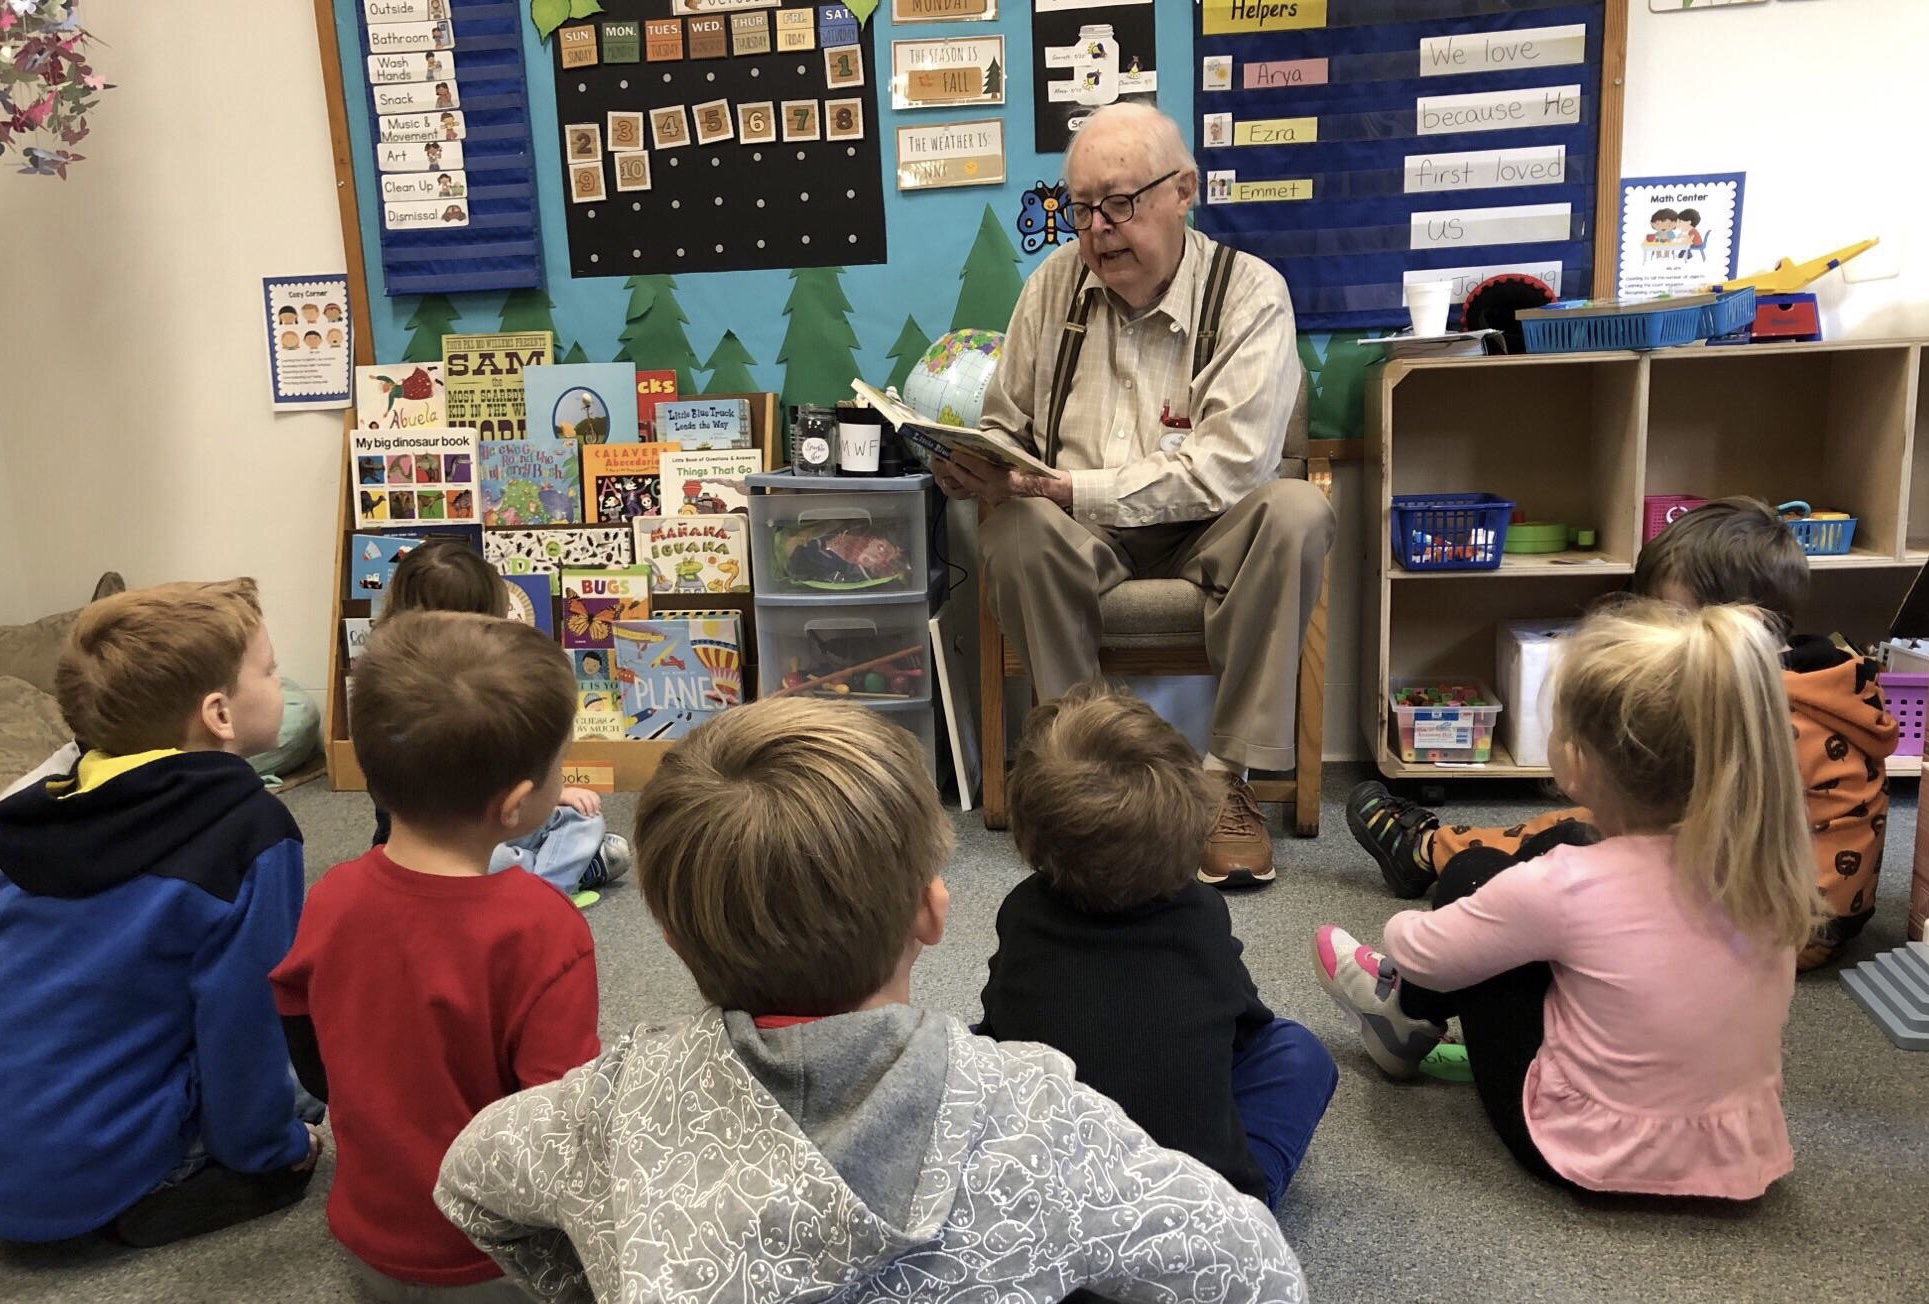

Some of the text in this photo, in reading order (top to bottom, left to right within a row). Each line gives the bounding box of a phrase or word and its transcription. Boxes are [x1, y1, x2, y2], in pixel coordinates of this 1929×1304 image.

[370, 1, 414, 15] Outside
[825, 9, 854, 20] SAT.
[1231, 0, 1298, 26] Helpers
[606, 26, 636, 36] MON.
[648, 24, 682, 35] TUES.
[692, 21, 723, 32] WED.
[372, 33, 429, 46] Bathroom
[566, 31, 591, 41] SUN.
[568, 50, 592, 63] SUNDAY
[909, 49, 924, 64] THE
[930, 46, 963, 63] SEASON
[1430, 37, 1540, 66] We love
[377, 57, 409, 68] Wash
[838, 55, 852, 77] 1
[377, 69, 412, 81] Hands
[1258, 63, 1303, 86] Arya
[943, 72, 969, 93] FALL
[380, 93, 414, 105] Snack
[1423, 92, 1576, 129] because He
[388, 116, 431, 130] Music &
[662, 116, 678, 137] 4
[705, 110, 722, 133] 5
[750, 112, 765, 132] 6
[793, 109, 809, 130] 7
[836, 108, 854, 130] 8
[381, 130, 438, 142] Movement
[617, 121, 634, 142] 3
[1250, 125, 1296, 143] Ezra
[576, 133, 592, 154] 2
[908, 136, 927, 152] THE
[931, 134, 973, 151] WEATHER
[387, 150, 407, 162] Art
[621, 160, 645, 180] 10
[1415, 149, 1562, 185] first loved
[384, 181, 434, 194] Clean Up
[580, 171, 596, 192] 9
[1240, 183, 1299, 200] Emmet
[1650, 193, 1708, 203] Math Center
[388, 209, 438, 222] Dismissal
[288, 291, 304, 299] Cozy
[448, 351, 544, 376] SAM
[448, 390, 475, 403] MOST
[390, 402, 438, 429] Abuela
[448, 404, 466, 418] KID
[471, 404, 481, 418] IN
[487, 403, 507, 417] THE
[668, 407, 735, 420] Little Blue Truck
[675, 420, 728, 431] Leads the Way
[356, 437, 470, 450] My big dinosaur book
[537, 451, 554, 464] the
[676, 465, 752, 477] Things That Go
[651, 541, 729, 559] IGUANA
[581, 579, 630, 594] BUGS
[590, 682, 600, 690] IS
[603, 682, 618, 690] YO
[634, 676, 728, 710] PLANES
[561, 768, 590, 784] ooks
